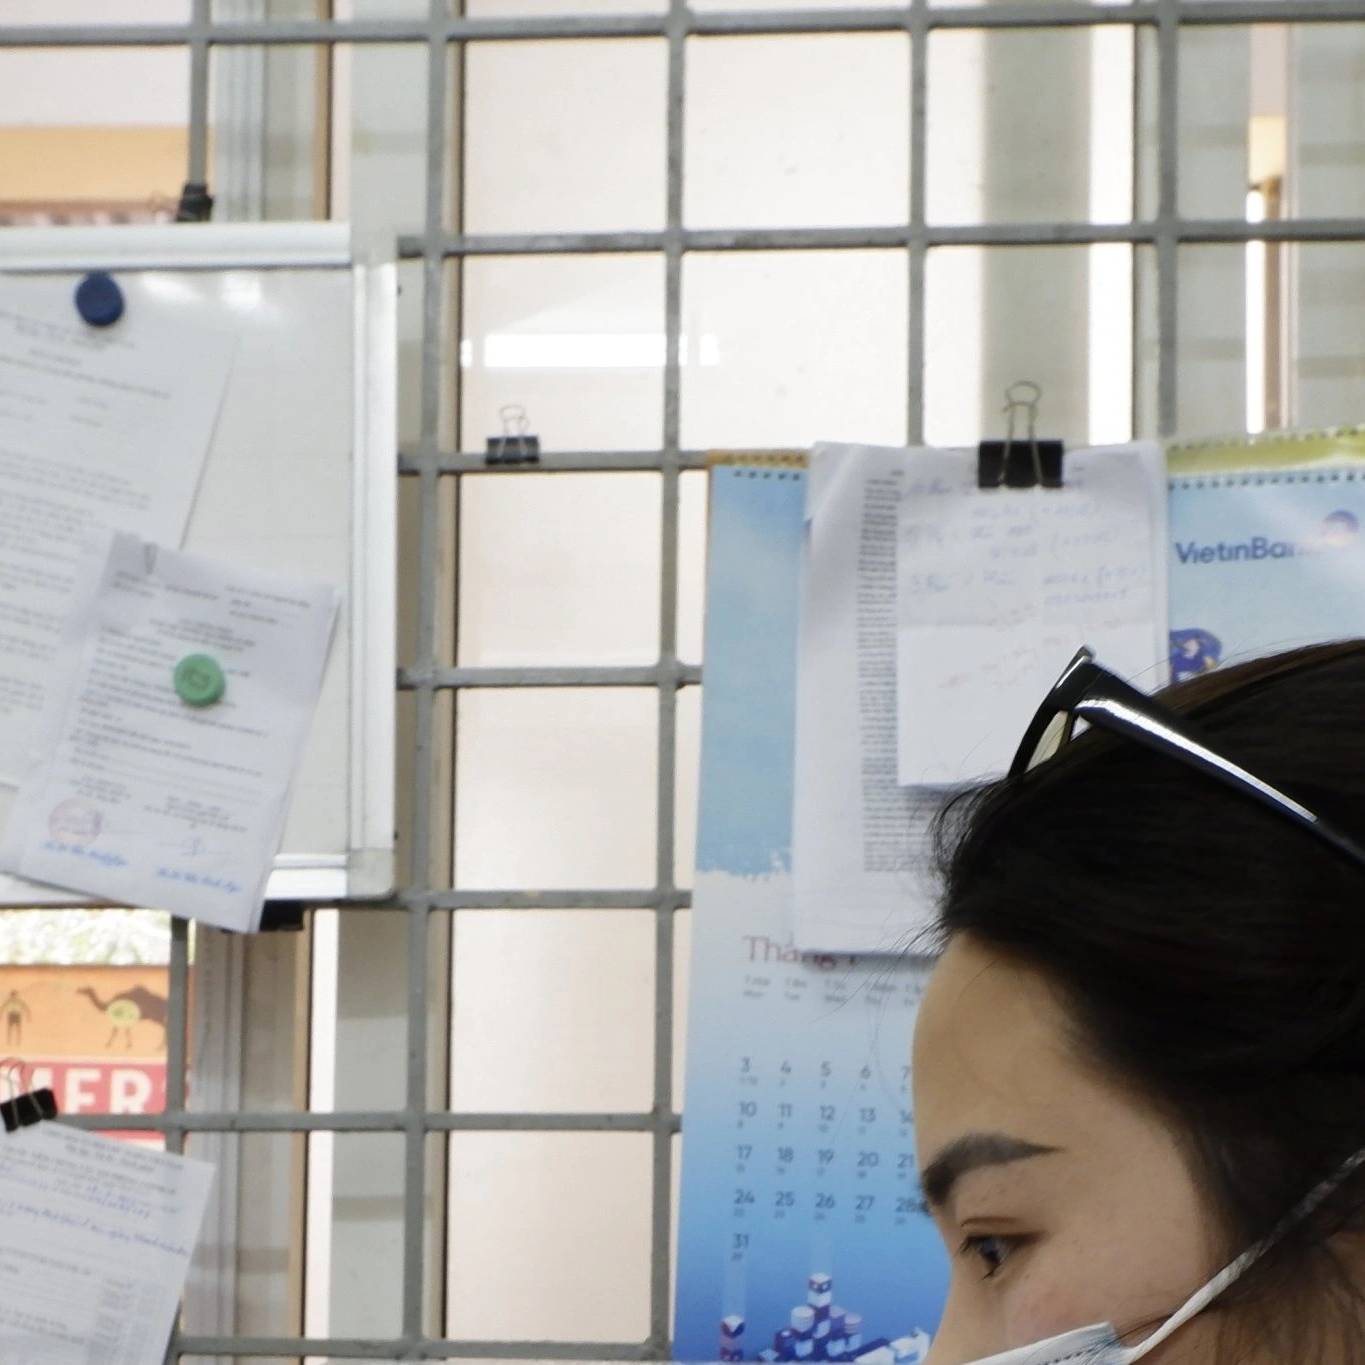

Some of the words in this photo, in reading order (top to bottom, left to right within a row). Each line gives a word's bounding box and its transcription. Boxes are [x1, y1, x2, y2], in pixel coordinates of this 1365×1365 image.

[741, 1057, 750, 1073] 3
[781, 1060, 791, 1073] 4
[821, 1061, 832, 1077] 5
[860, 1065, 871, 1079] 6
[901, 1065, 910, 1079] 7
[740, 1101, 757, 1117] 10
[779, 1103, 792, 1117] 11
[820, 1105, 835, 1121] 12
[860, 1107, 875, 1123] 13
[738, 1144, 752, 1160] 17
[778, 1146, 794, 1163] 18
[818, 1149, 834, 1164] 19
[857, 1151, 879, 1168] 20
[897, 1153, 914, 1169] 21
[735, 1188, 755, 1205] 24
[775, 1190, 795, 1207] 25
[815, 1192, 835, 1209] 26
[855, 1194, 875, 1211] 27
[733, 1233, 749, 1250] 31
